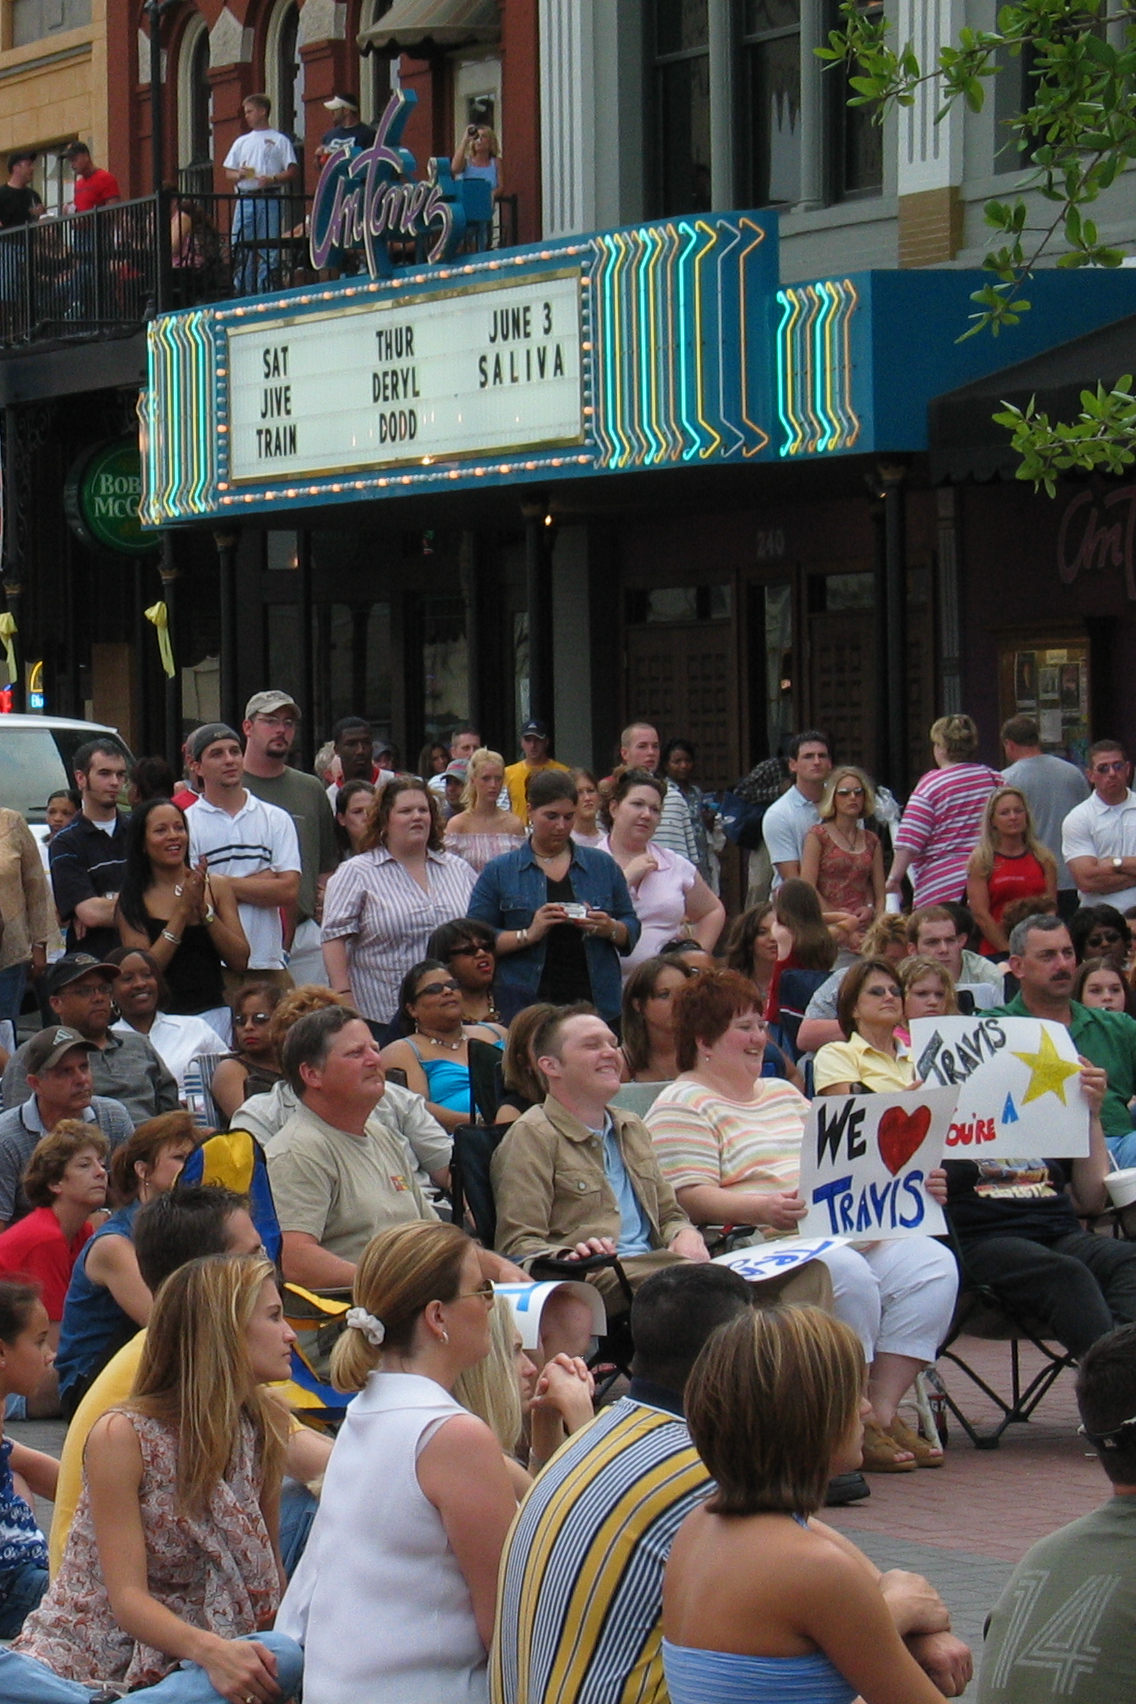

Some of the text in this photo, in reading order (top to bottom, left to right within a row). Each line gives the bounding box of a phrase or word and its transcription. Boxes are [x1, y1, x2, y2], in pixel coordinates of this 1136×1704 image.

[489, 301, 554, 343] JUNE 3
[262, 345, 289, 380] SAT
[375, 325, 415, 362] THUR
[372, 366, 421, 404] DERYL
[478, 343, 565, 389] SALIVA
[260, 384, 292, 420] JIVE
[255, 424, 298, 460] TRAIN
[379, 408, 418, 444] DODD
[916, 1018, 1007, 1087] TRAVIS
[817, 1097, 867, 1169] WE
[945, 1090, 1020, 1147] OU'RE A
[812, 1169, 926, 1235] TRAVIS
[990, 1569, 1123, 1696] 14
